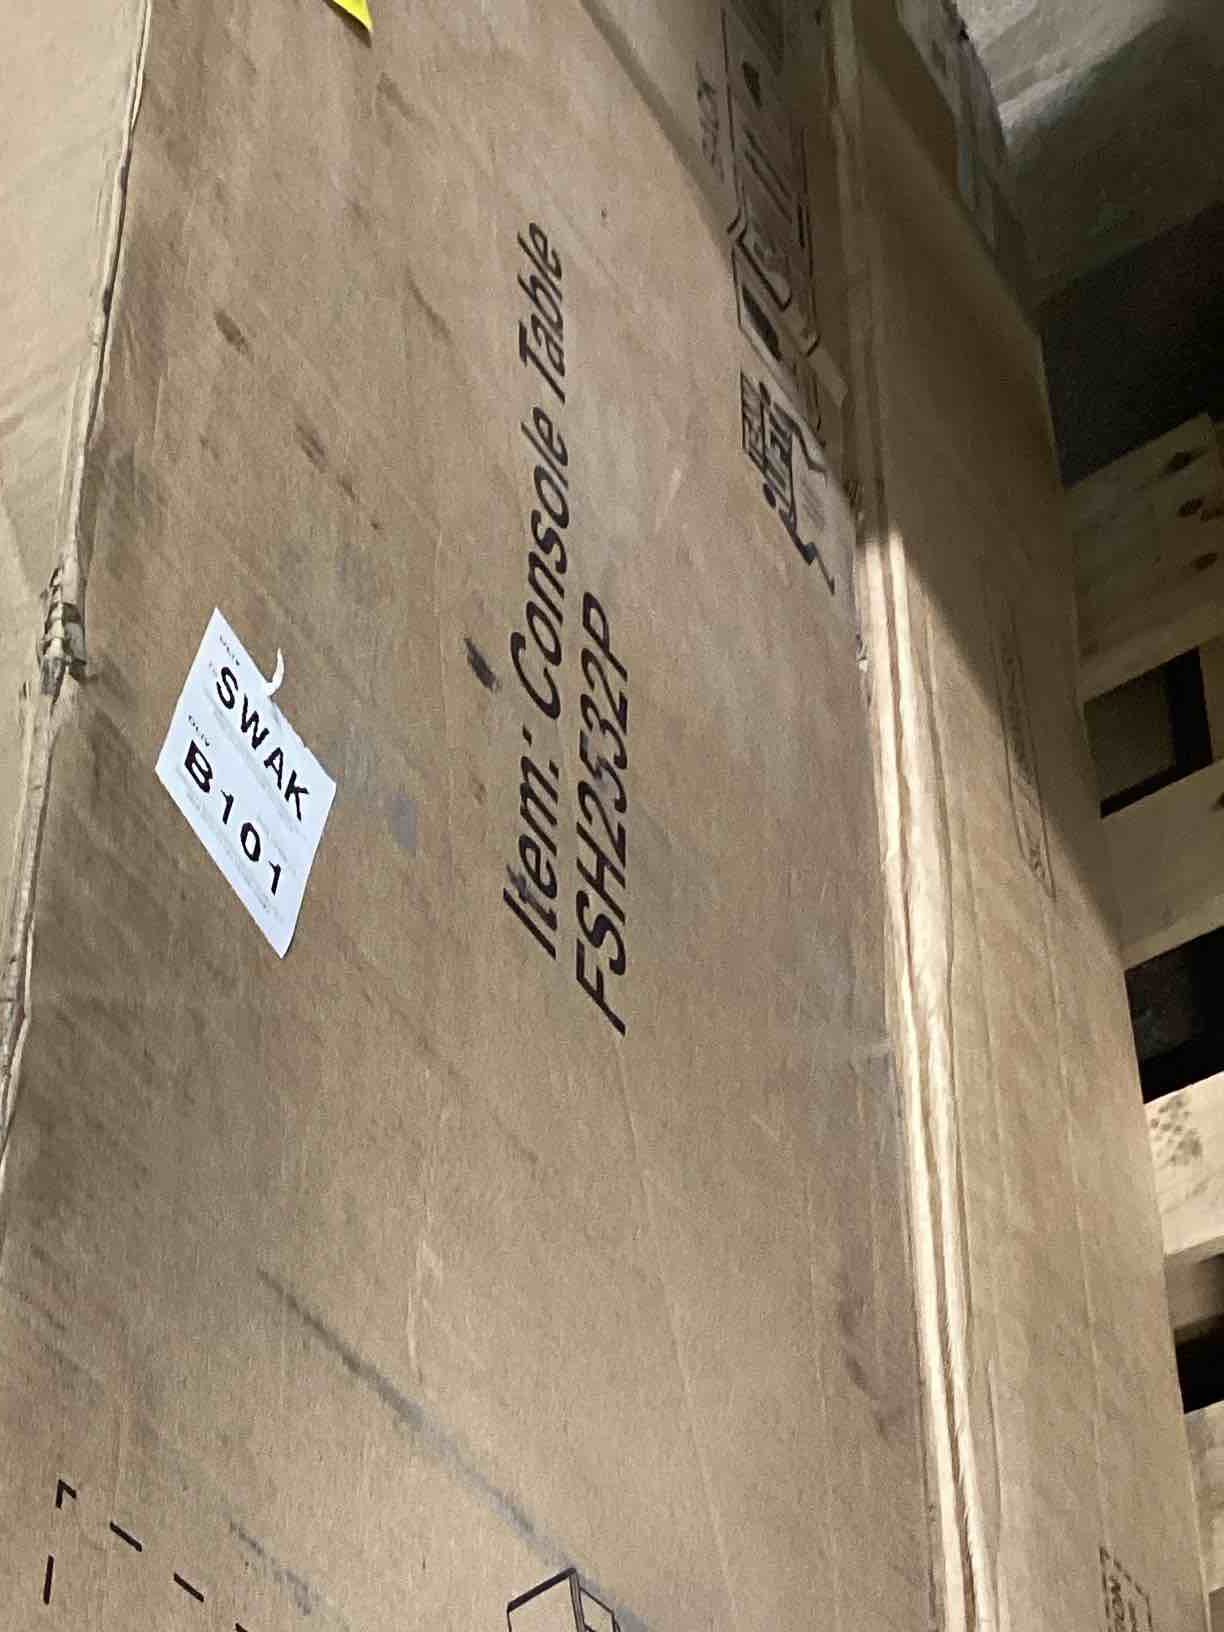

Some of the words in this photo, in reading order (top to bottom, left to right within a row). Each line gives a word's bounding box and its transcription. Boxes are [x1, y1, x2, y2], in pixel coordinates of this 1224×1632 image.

[517, 222, 565, 404] Table
[511, 407, 569, 720] Console
[184, 739, 282, 896] B101
[216, 666, 309, 822] SWAK
[503, 725, 559, 960] Item:
[575, 592, 627, 1037] FSH2532P
